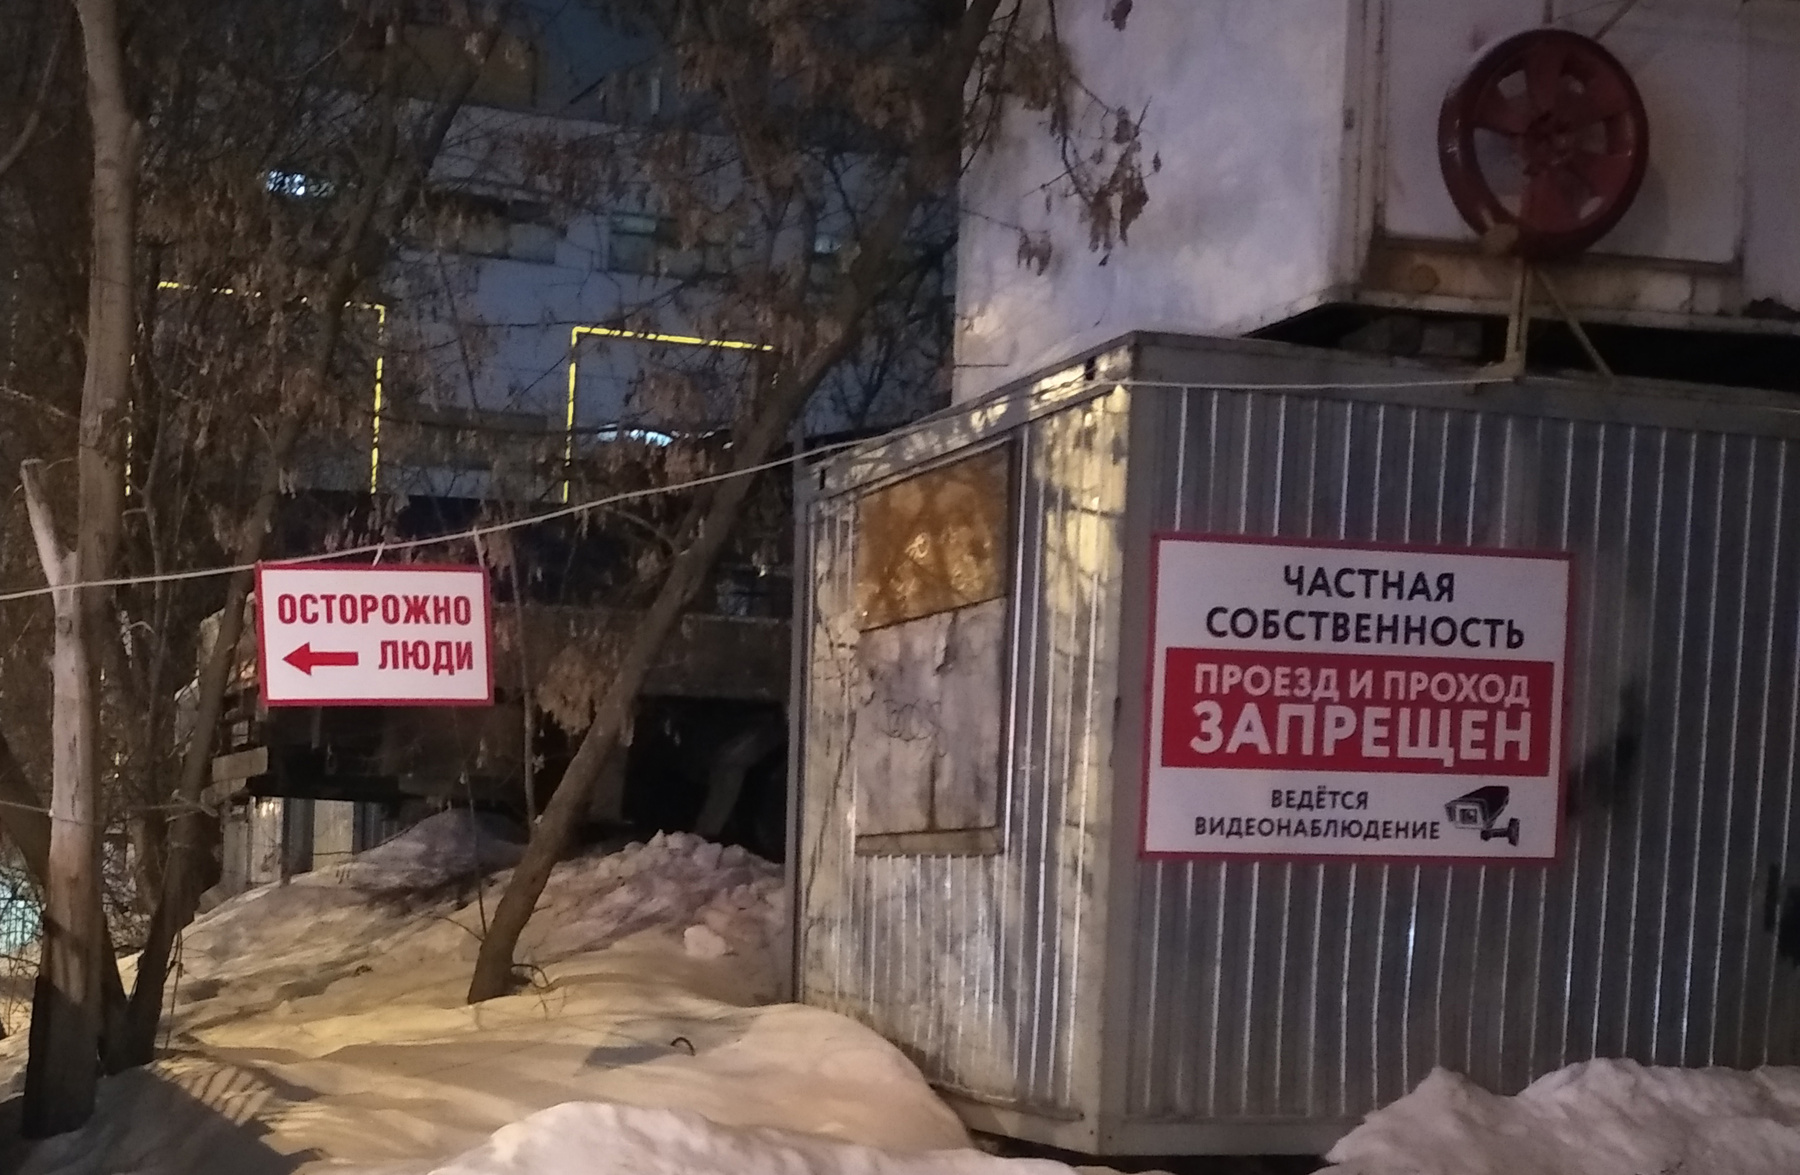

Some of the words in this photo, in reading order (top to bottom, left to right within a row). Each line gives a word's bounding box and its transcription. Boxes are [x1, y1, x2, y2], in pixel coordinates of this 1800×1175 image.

[1283, 564, 1455, 602] ЧАСТНАЯ
[278, 593, 472, 625] ОСТОРОЖНО
[1206, 606, 1525, 649] СОБСТВЕННОСТЬ
[378, 640, 473, 675] ЛЮДИ
[1195, 663, 1339, 702] ПРОЕЗД
[1349, 669, 1373, 698] И
[1383, 670, 1530, 708] ПРОХОД
[1190, 701, 1531, 767] ЗАПРЕЩЕН
[1271, 785, 1369, 811] ВЕДЁТСЯ
[1195, 816, 1440, 841] ВИДЕОНАБЛЮДЕНИЕ
